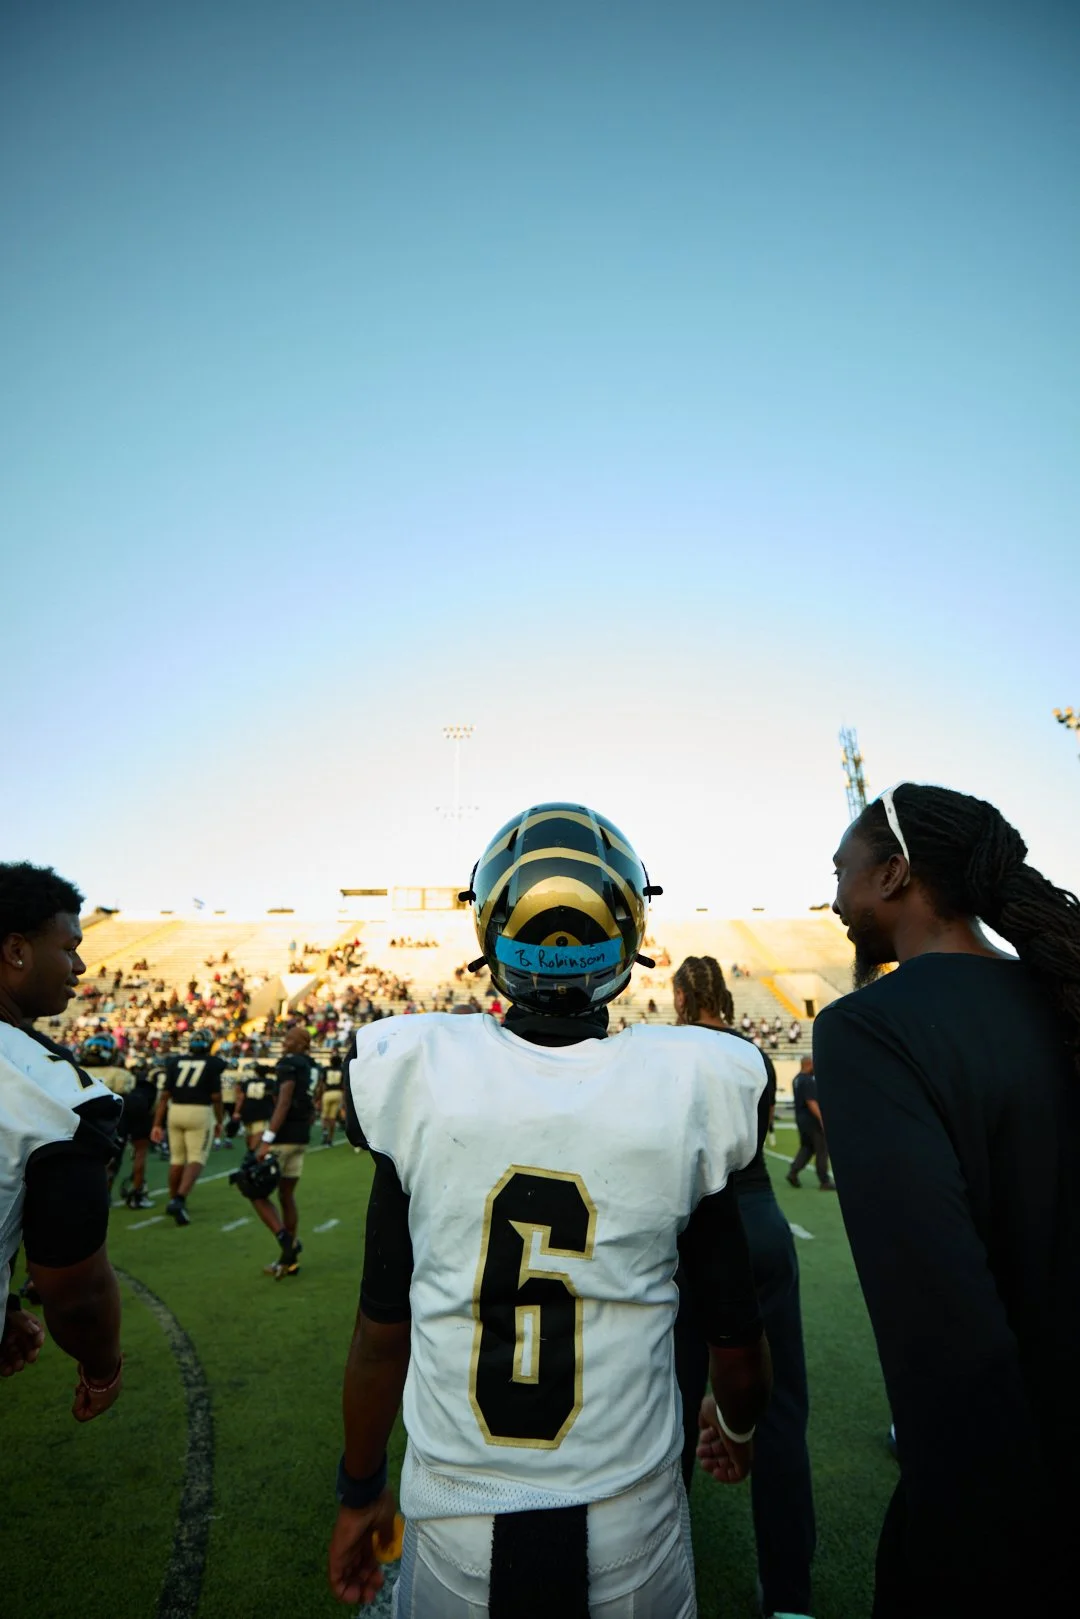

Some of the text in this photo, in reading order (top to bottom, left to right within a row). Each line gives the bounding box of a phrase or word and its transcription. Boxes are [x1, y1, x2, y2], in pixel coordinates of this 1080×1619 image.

[538, 949, 606, 969] Robinson
[175, 1060, 206, 1088] 77
[468, 1163, 598, 1449] 6
